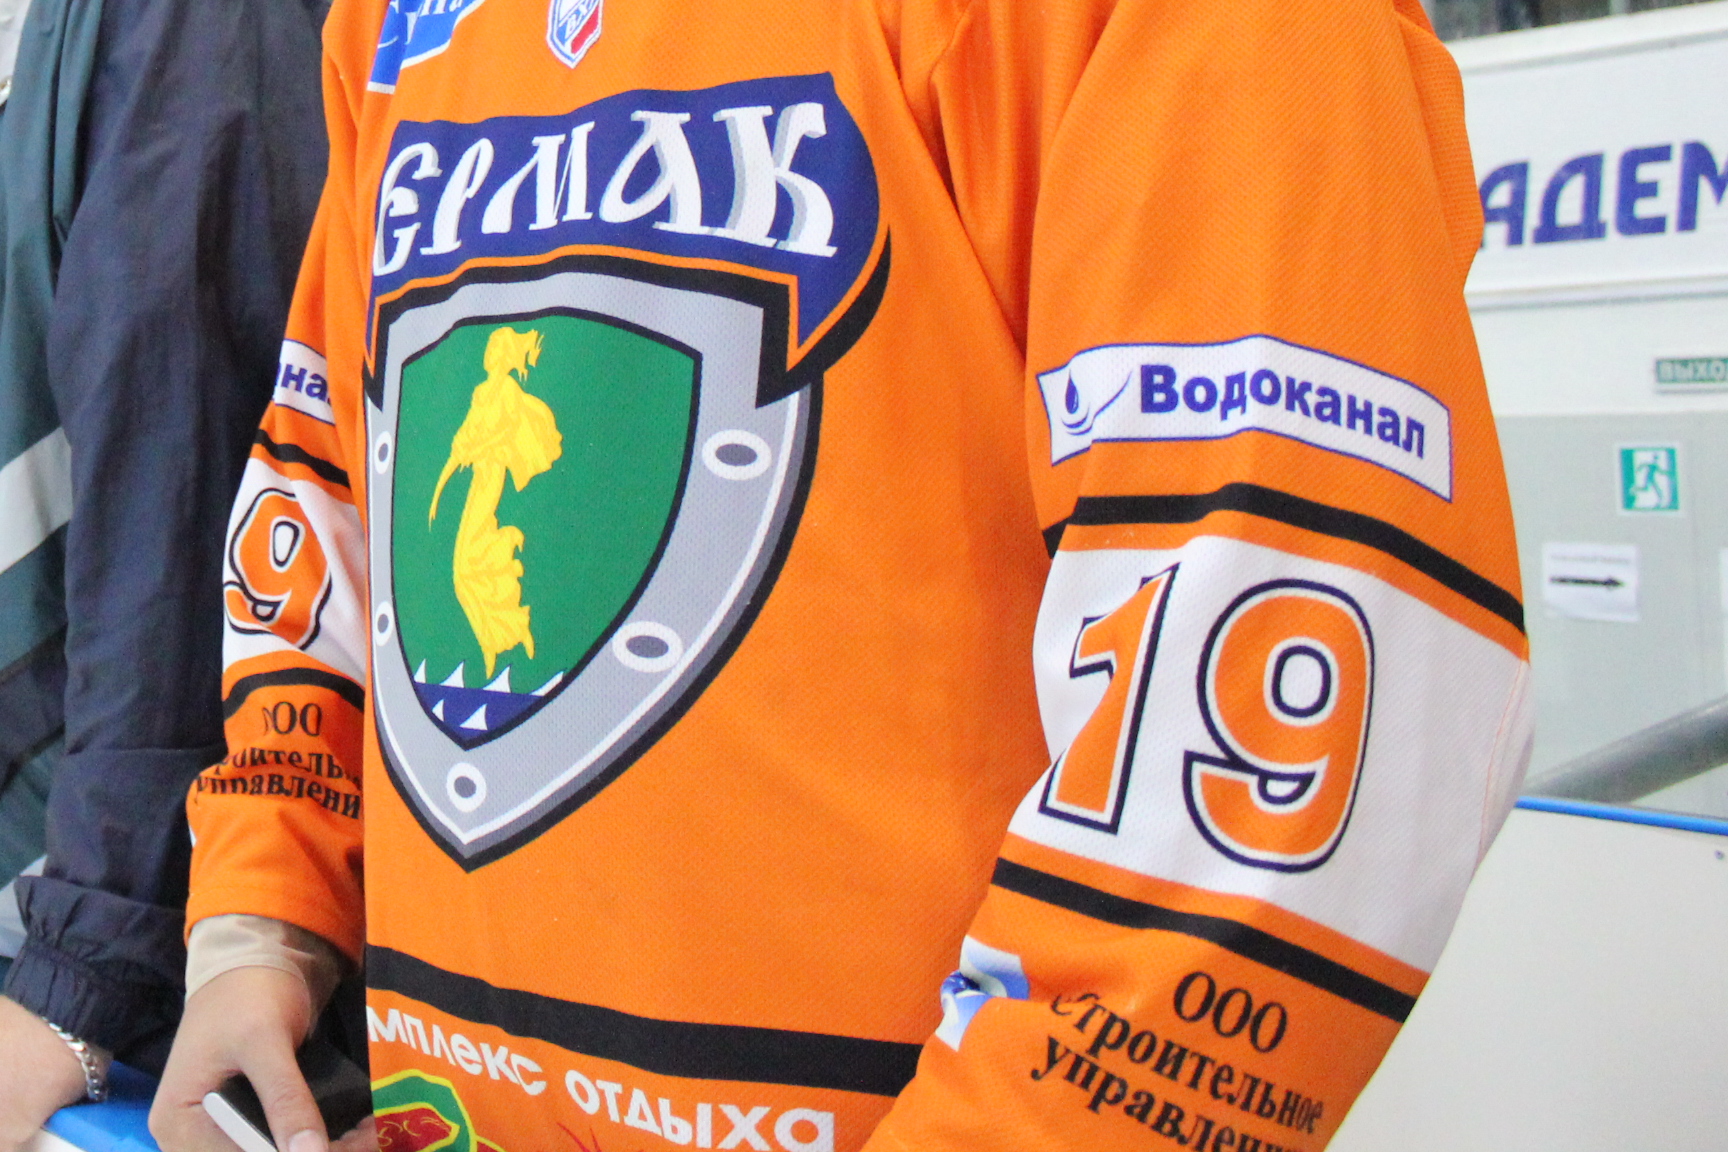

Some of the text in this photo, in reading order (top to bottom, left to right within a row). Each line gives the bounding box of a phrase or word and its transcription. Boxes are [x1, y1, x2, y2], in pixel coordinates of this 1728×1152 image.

[1140, 364, 1425, 460] Водоканал
[1039, 562, 1375, 875] 19
[1173, 971, 1288, 1054] ООО
